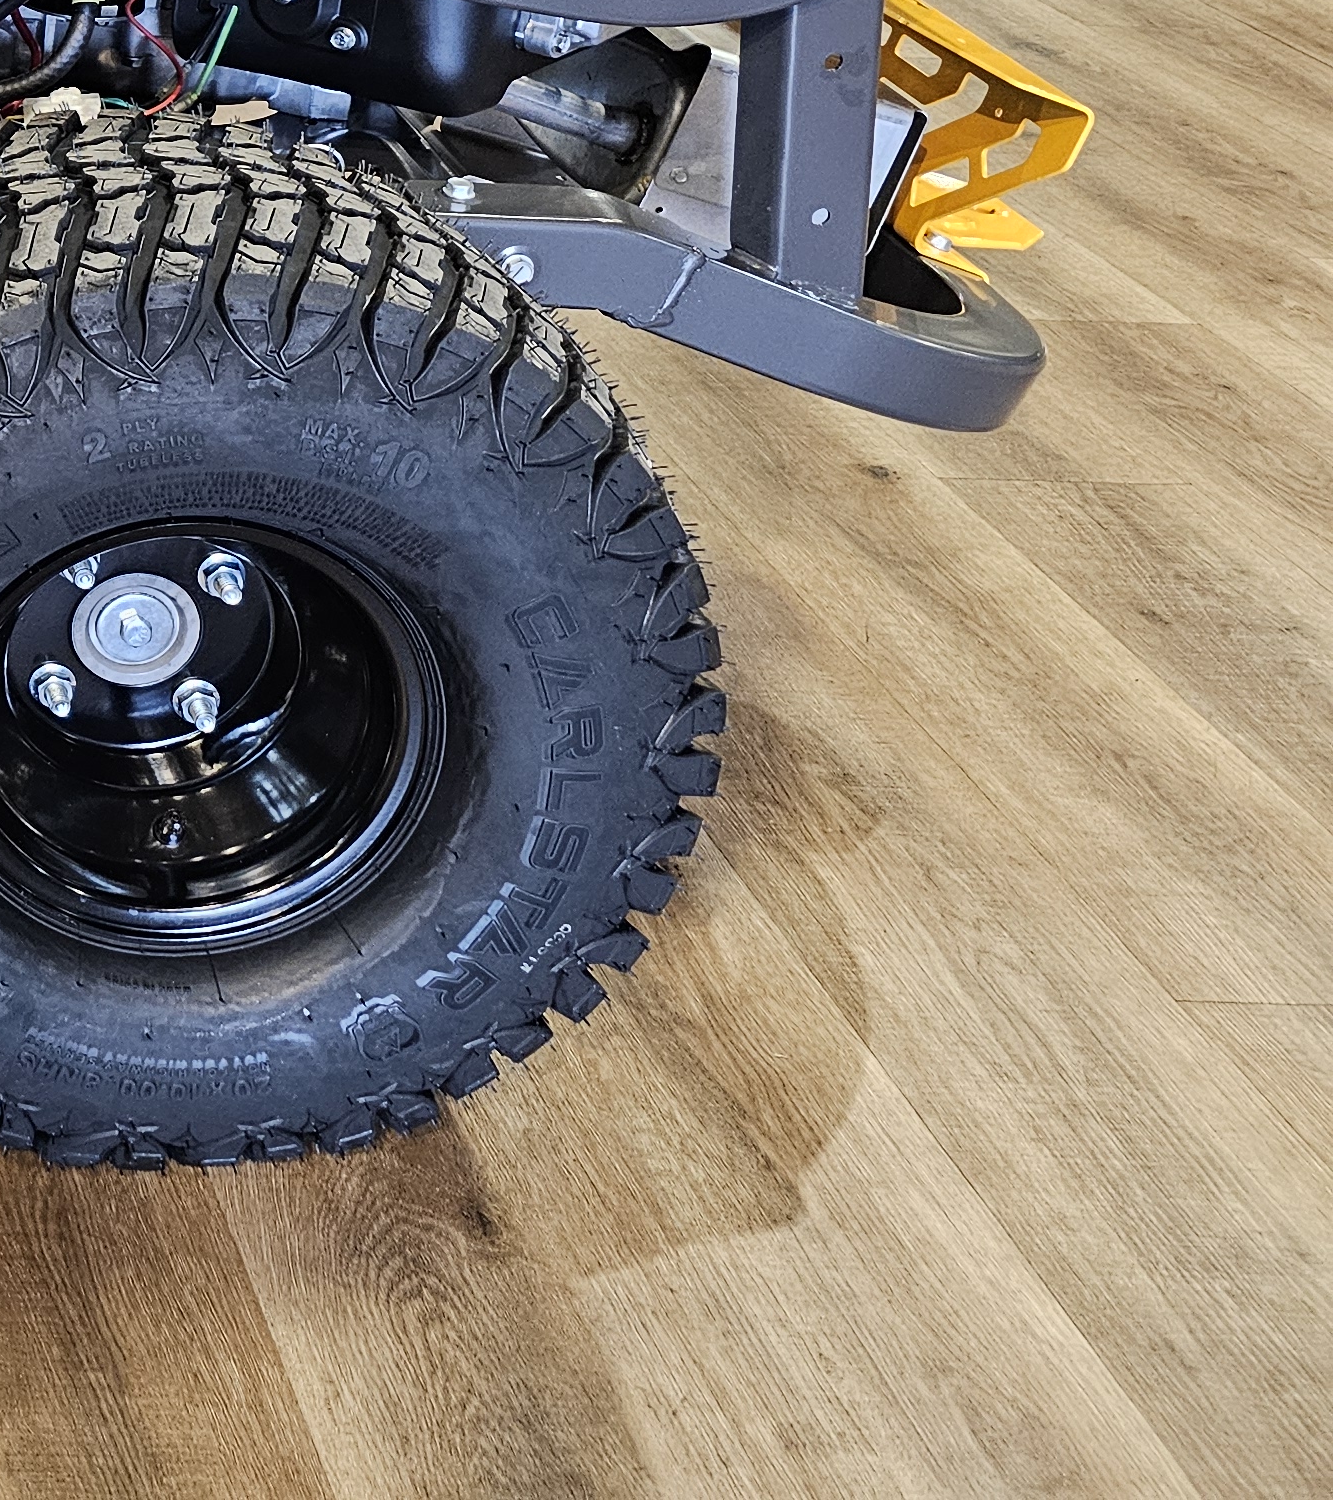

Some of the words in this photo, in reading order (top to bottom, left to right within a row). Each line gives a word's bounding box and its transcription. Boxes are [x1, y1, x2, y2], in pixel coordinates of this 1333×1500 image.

[122, 417, 158, 435] PLY
[81, 431, 112, 465] 2
[128, 434, 204, 454] RATING
[375, 440, 431, 489] 10
[416, 594, 605, 1011] CARLSTAR
